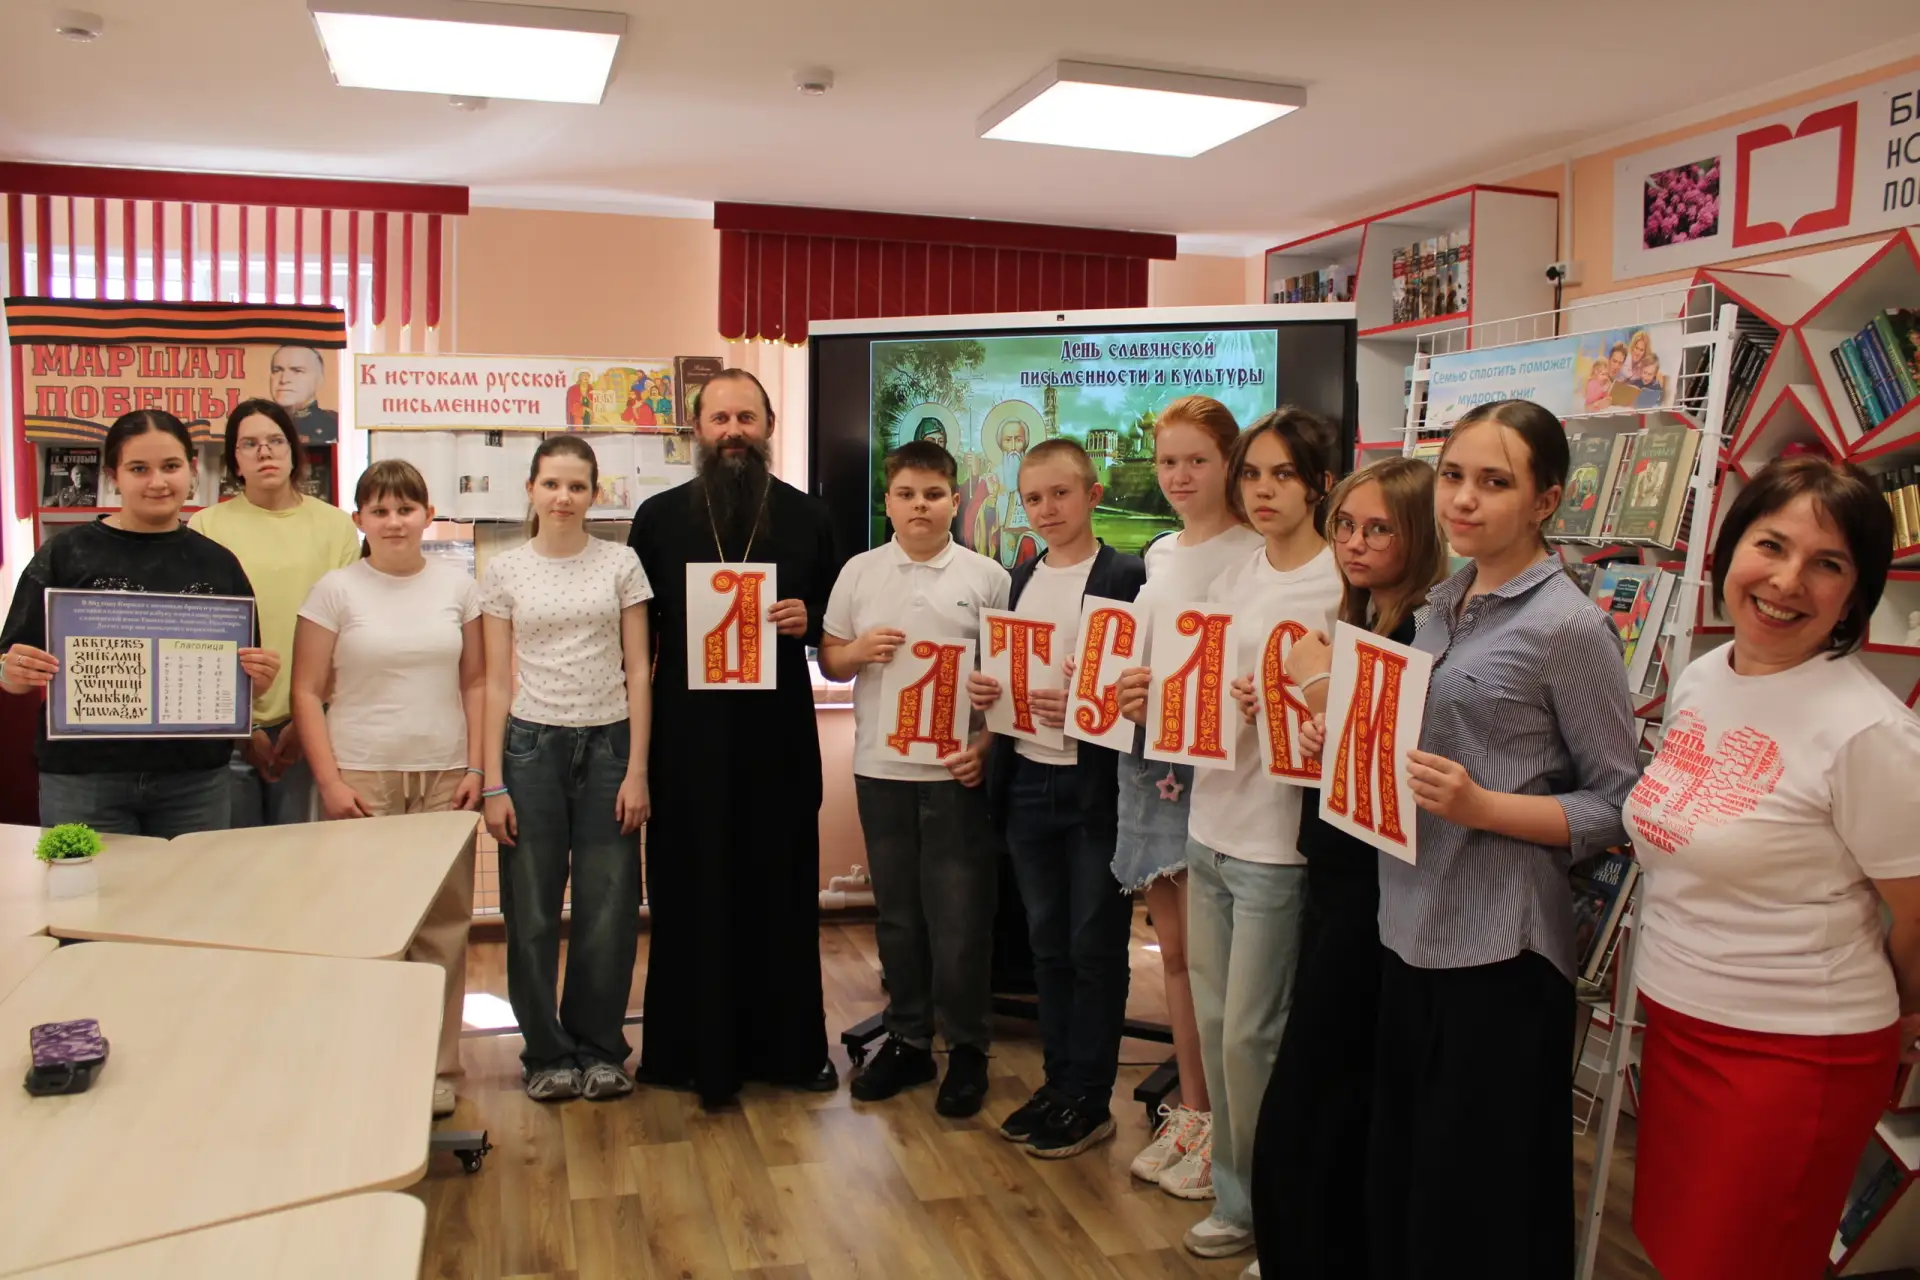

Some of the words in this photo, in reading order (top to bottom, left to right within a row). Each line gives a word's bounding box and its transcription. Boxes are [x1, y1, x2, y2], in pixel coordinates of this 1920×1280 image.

[1883, 176, 1920, 212] ПО
[32, 344, 246, 380] МАРШАЛ
[1061, 340, 1101, 361] День
[1109, 338, 1215, 358] славянской
[360, 364, 377, 385] К
[385, 370, 478, 386] истокам
[487, 369, 567, 393] русской
[1020, 369, 1147, 387] письменности
[1154, 368, 1165, 385] и
[1171, 367, 1264, 388] культуры
[1433, 371, 1468, 385] Семью
[1469, 364, 1517, 381] сплотить
[1519, 357, 1573, 375] поможет
[35, 385, 240, 422] ПОБЕДЫ
[382, 398, 540, 414] письменности
[1510, 387, 1536, 399] книг
[174, 640, 224, 652] Глаголица
[985, 615, 1056, 734] Т
[1667, 727, 1705, 752] ИТАТЬ
